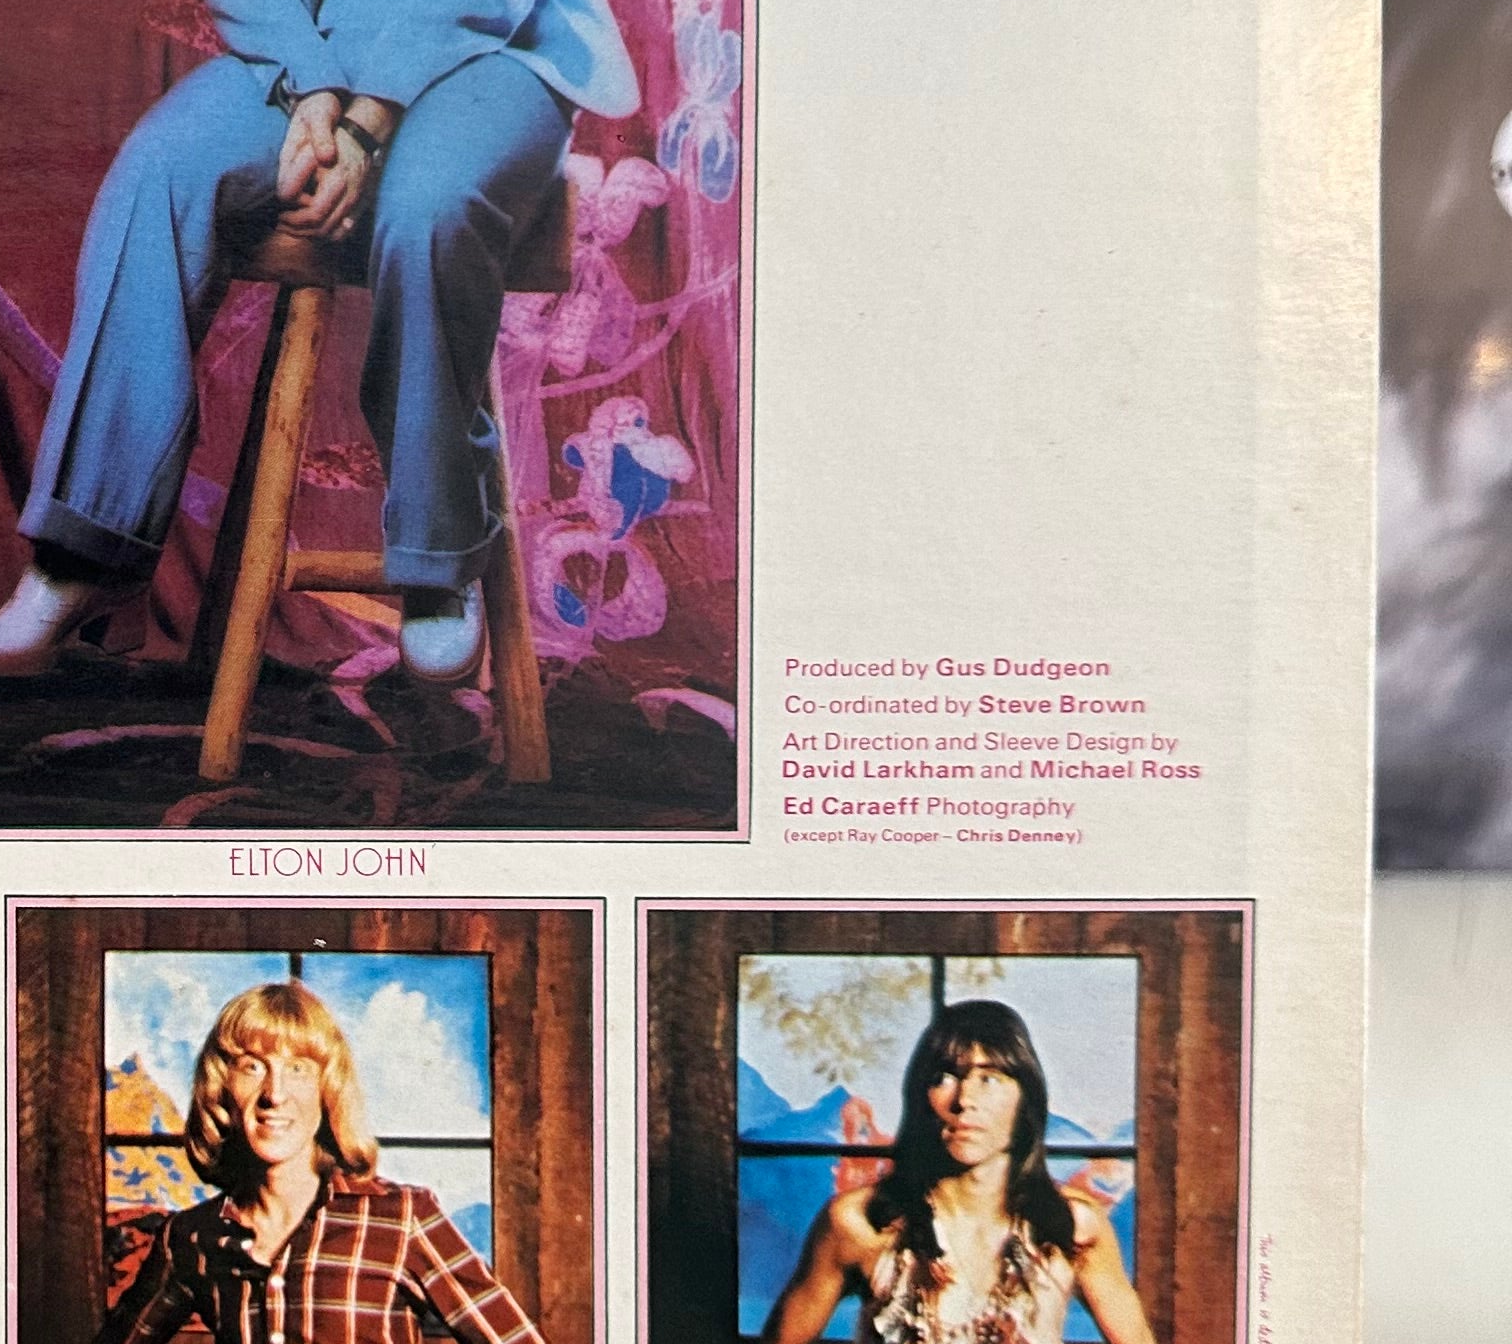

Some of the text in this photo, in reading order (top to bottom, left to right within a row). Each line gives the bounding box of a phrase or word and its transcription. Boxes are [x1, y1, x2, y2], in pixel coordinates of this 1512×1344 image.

[786, 658, 1109, 680] Produced by Gus Dudgeon
[785, 695, 1145, 717] Co-ordinated by Steve Brown
[783, 732, 1178, 755] Art Direction and Sleeve Design by
[783, 760, 1201, 779] David Larkham and Michael Ross
[784, 797, 1075, 819] Ed Caraeff Photography
[784, 829, 843, 843] (except
[848, 829, 877, 844] Ray
[881, 829, 939, 844] Cooper
[957, 829, 1003, 842] Chris
[1008, 829, 1082, 844] Denney)
[229, 848, 425, 876] ELTON JOHN
